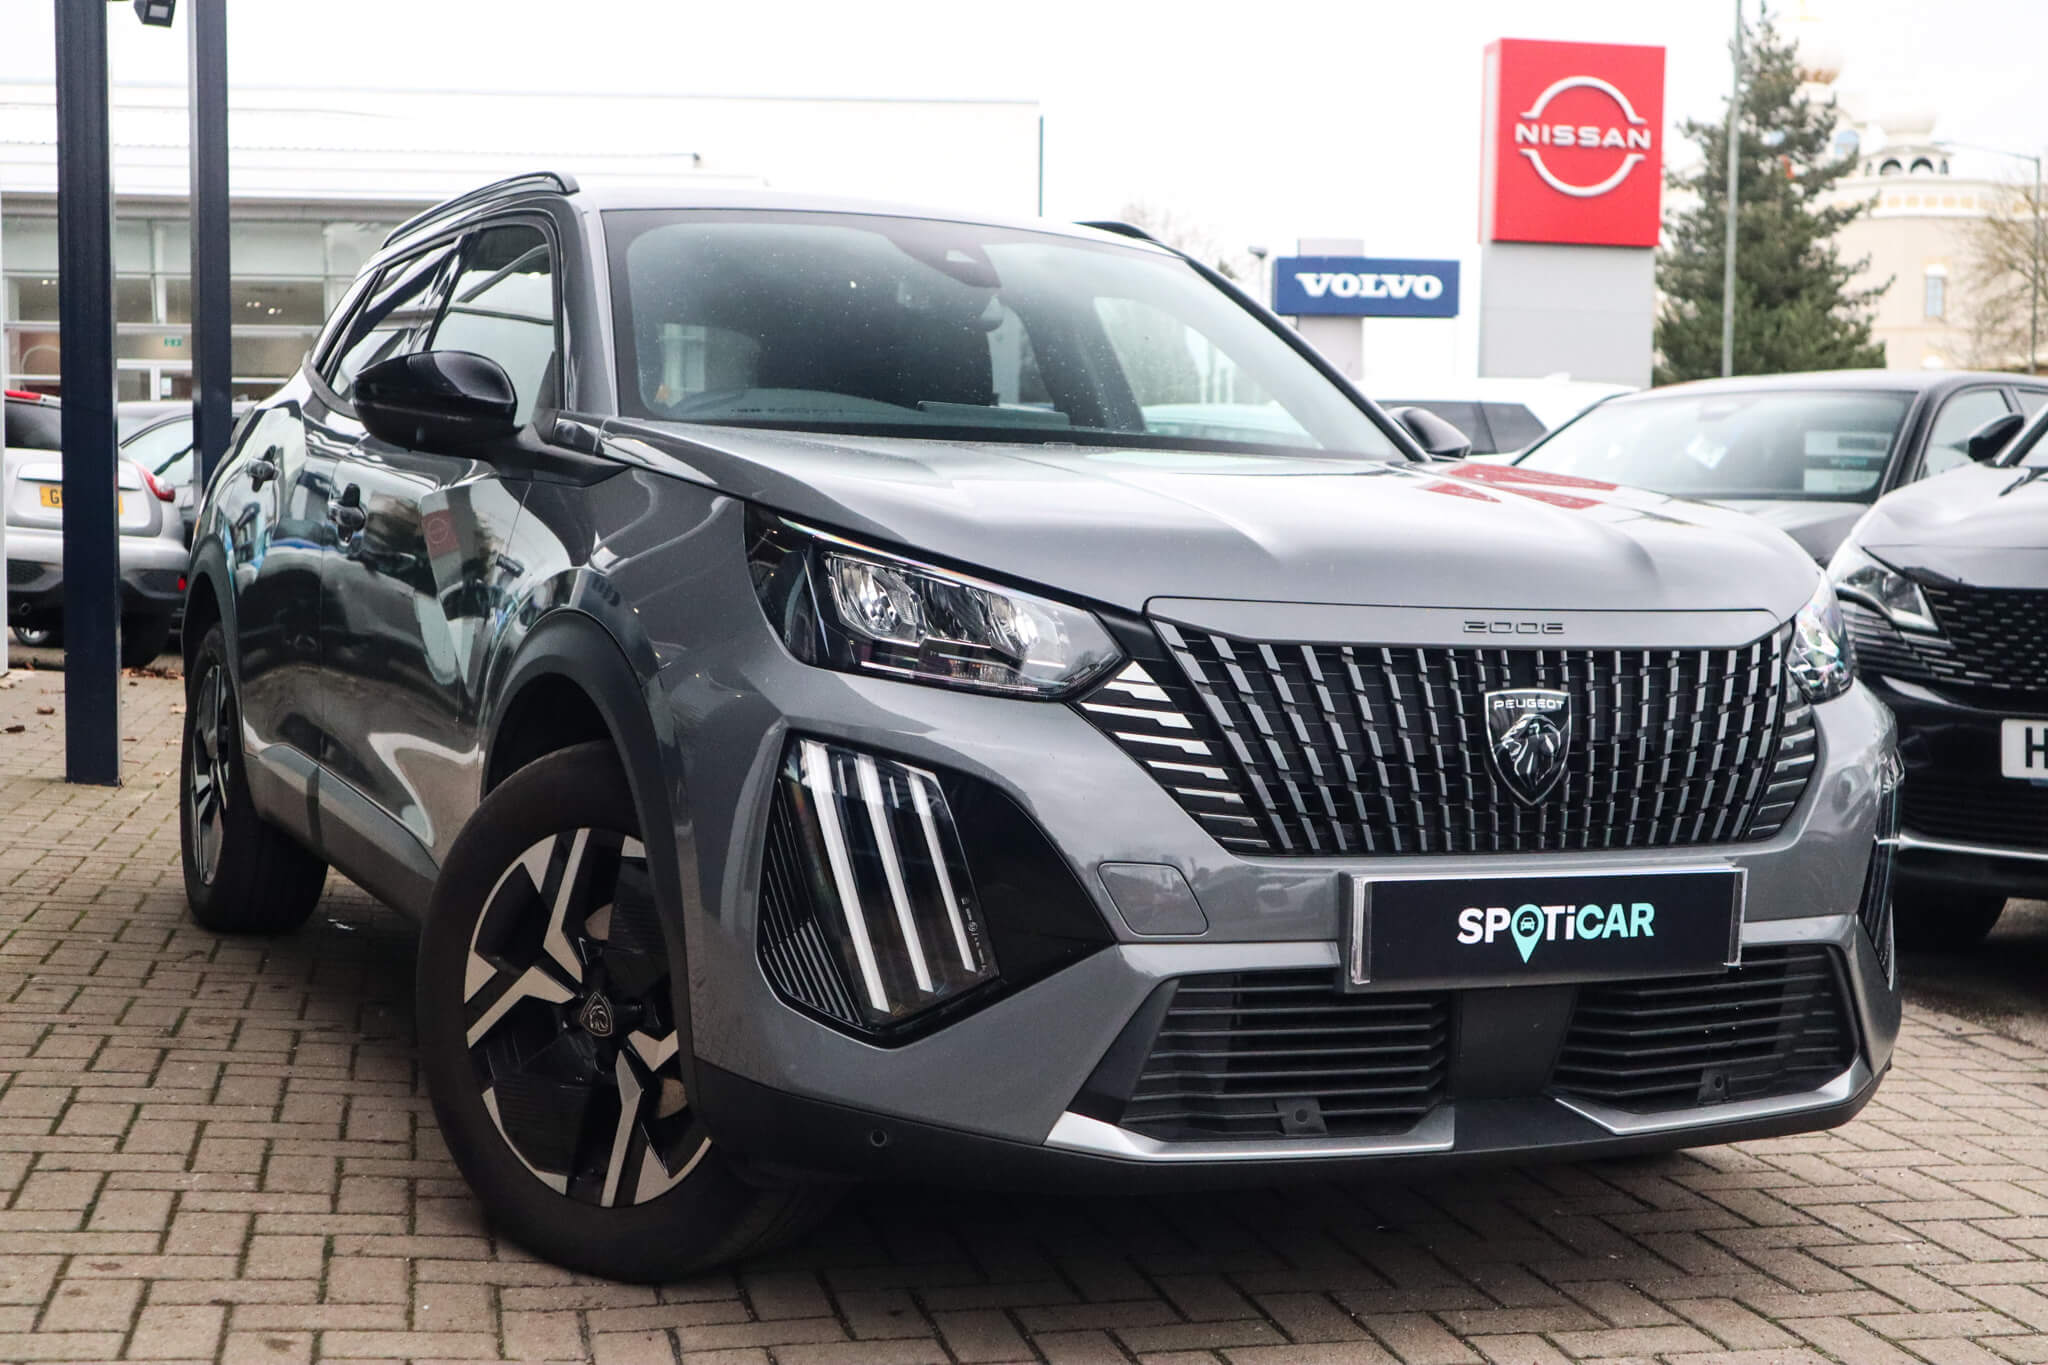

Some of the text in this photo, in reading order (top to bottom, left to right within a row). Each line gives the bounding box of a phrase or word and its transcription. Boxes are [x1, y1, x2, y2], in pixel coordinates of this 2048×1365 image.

[1514, 122, 1651, 150] NISSAN
[1295, 272, 1444, 300] VOLVO
[1463, 620, 1566, 635] 2008
[1493, 698, 1565, 711] PEUGEOT
